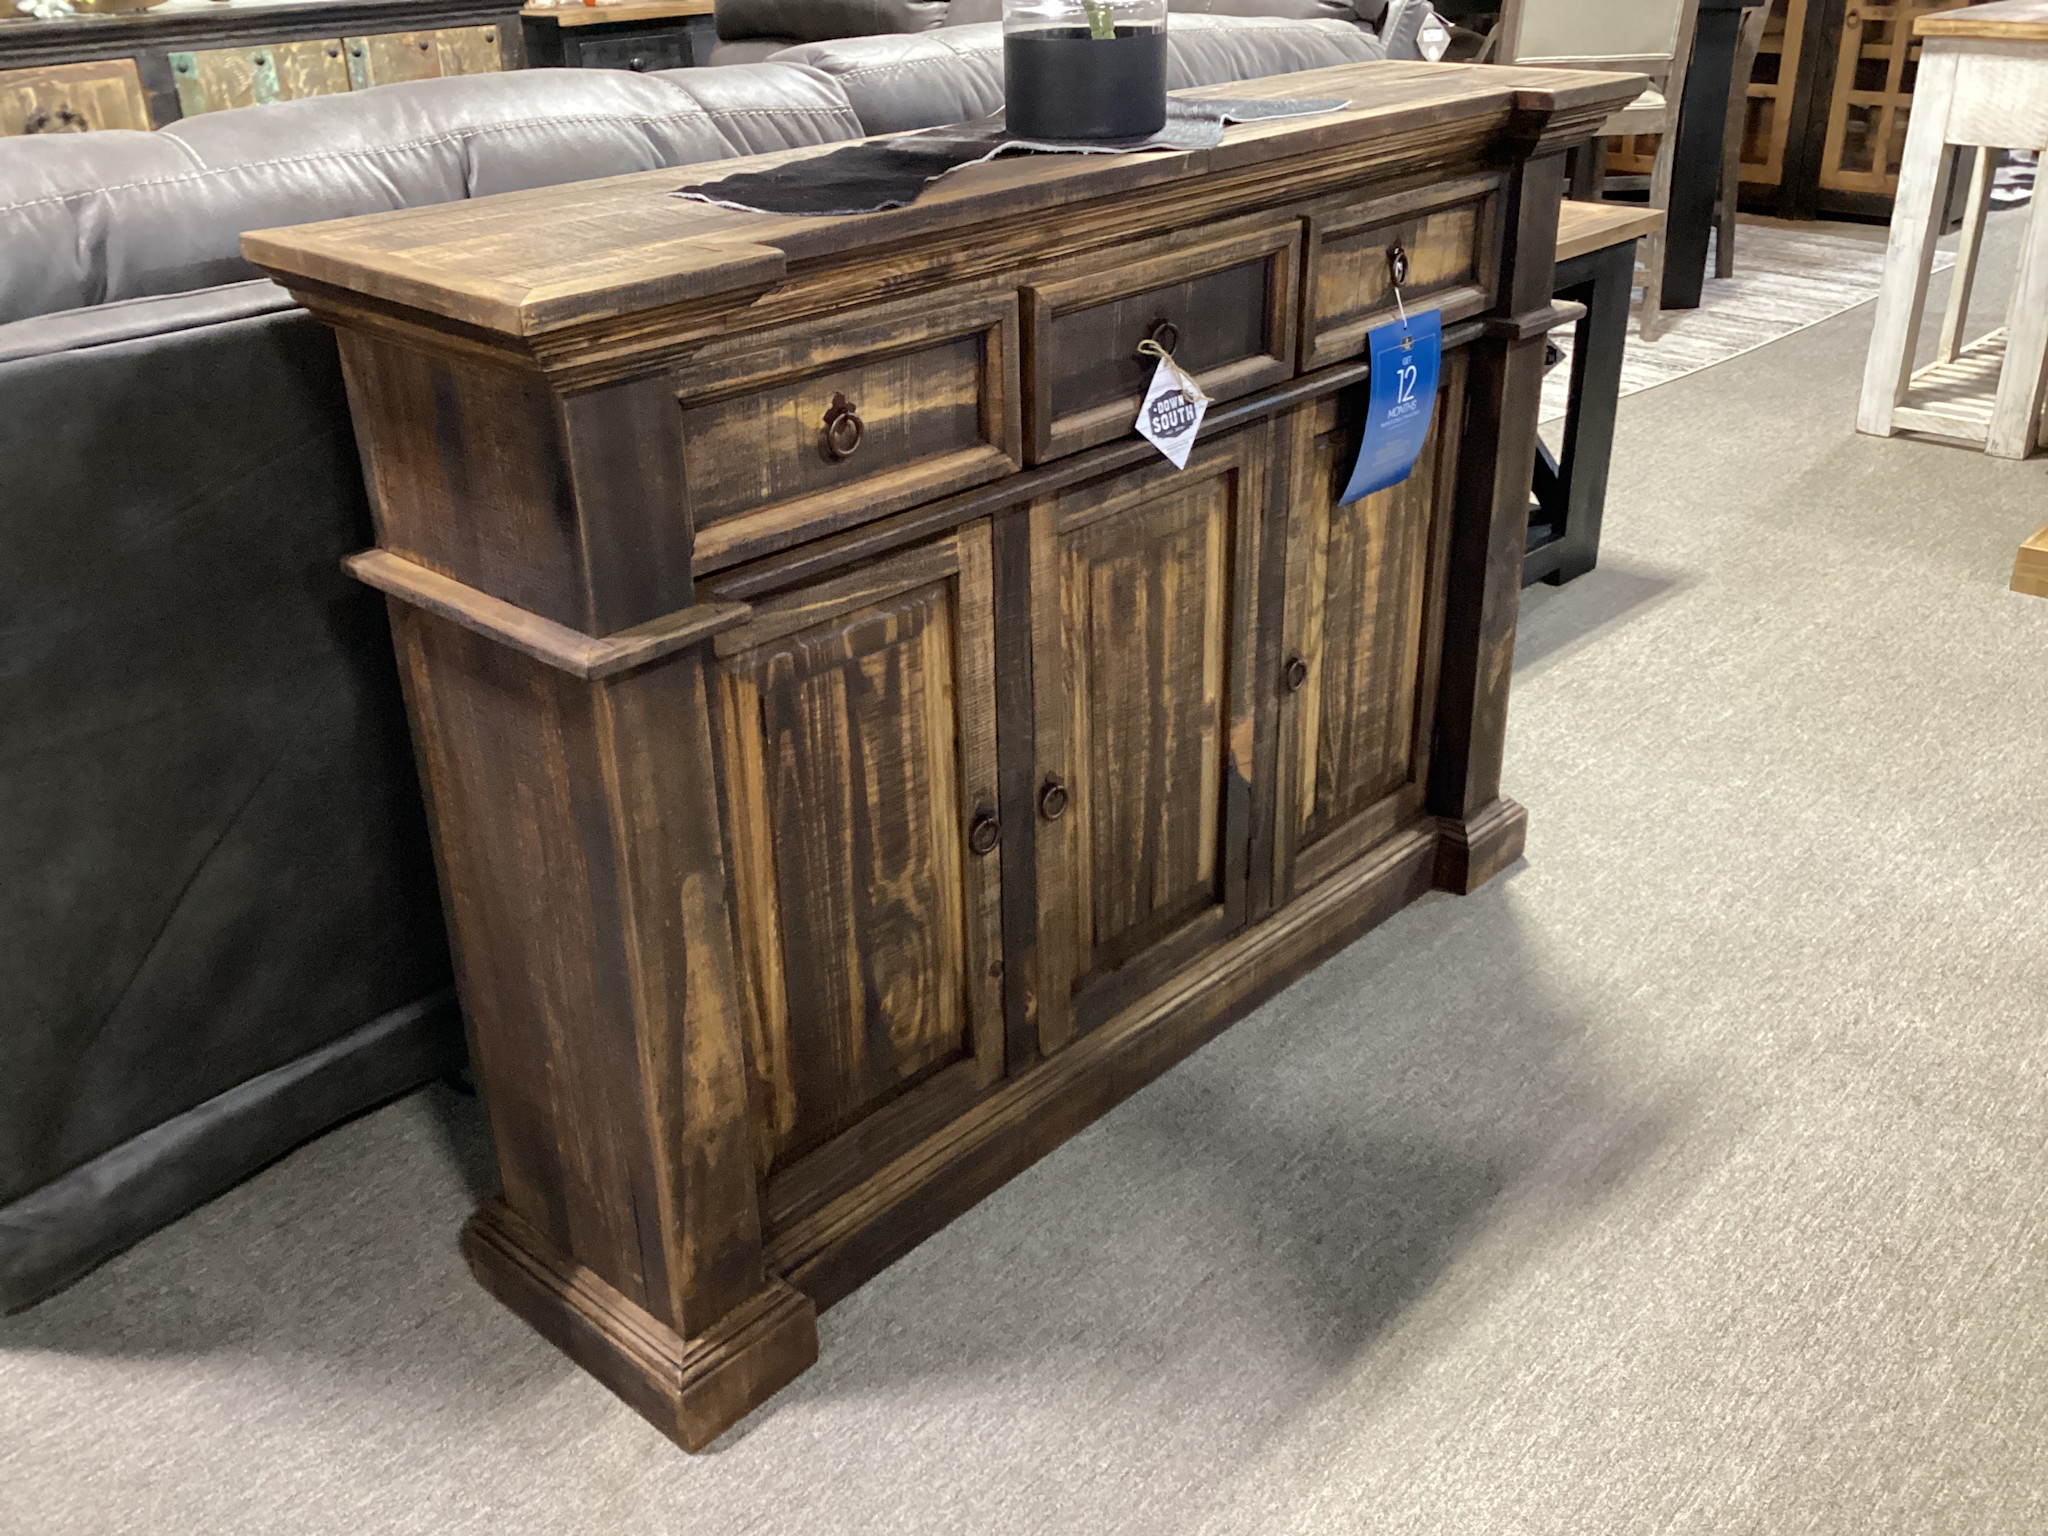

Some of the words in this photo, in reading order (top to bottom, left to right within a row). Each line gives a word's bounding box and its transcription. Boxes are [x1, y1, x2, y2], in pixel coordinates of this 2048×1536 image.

[1396, 365, 1417, 404] 12
[1156, 394, 1185, 414] DOWN
[1387, 399, 1418, 419] MONTHS
[1152, 404, 1195, 433] SOUTH
